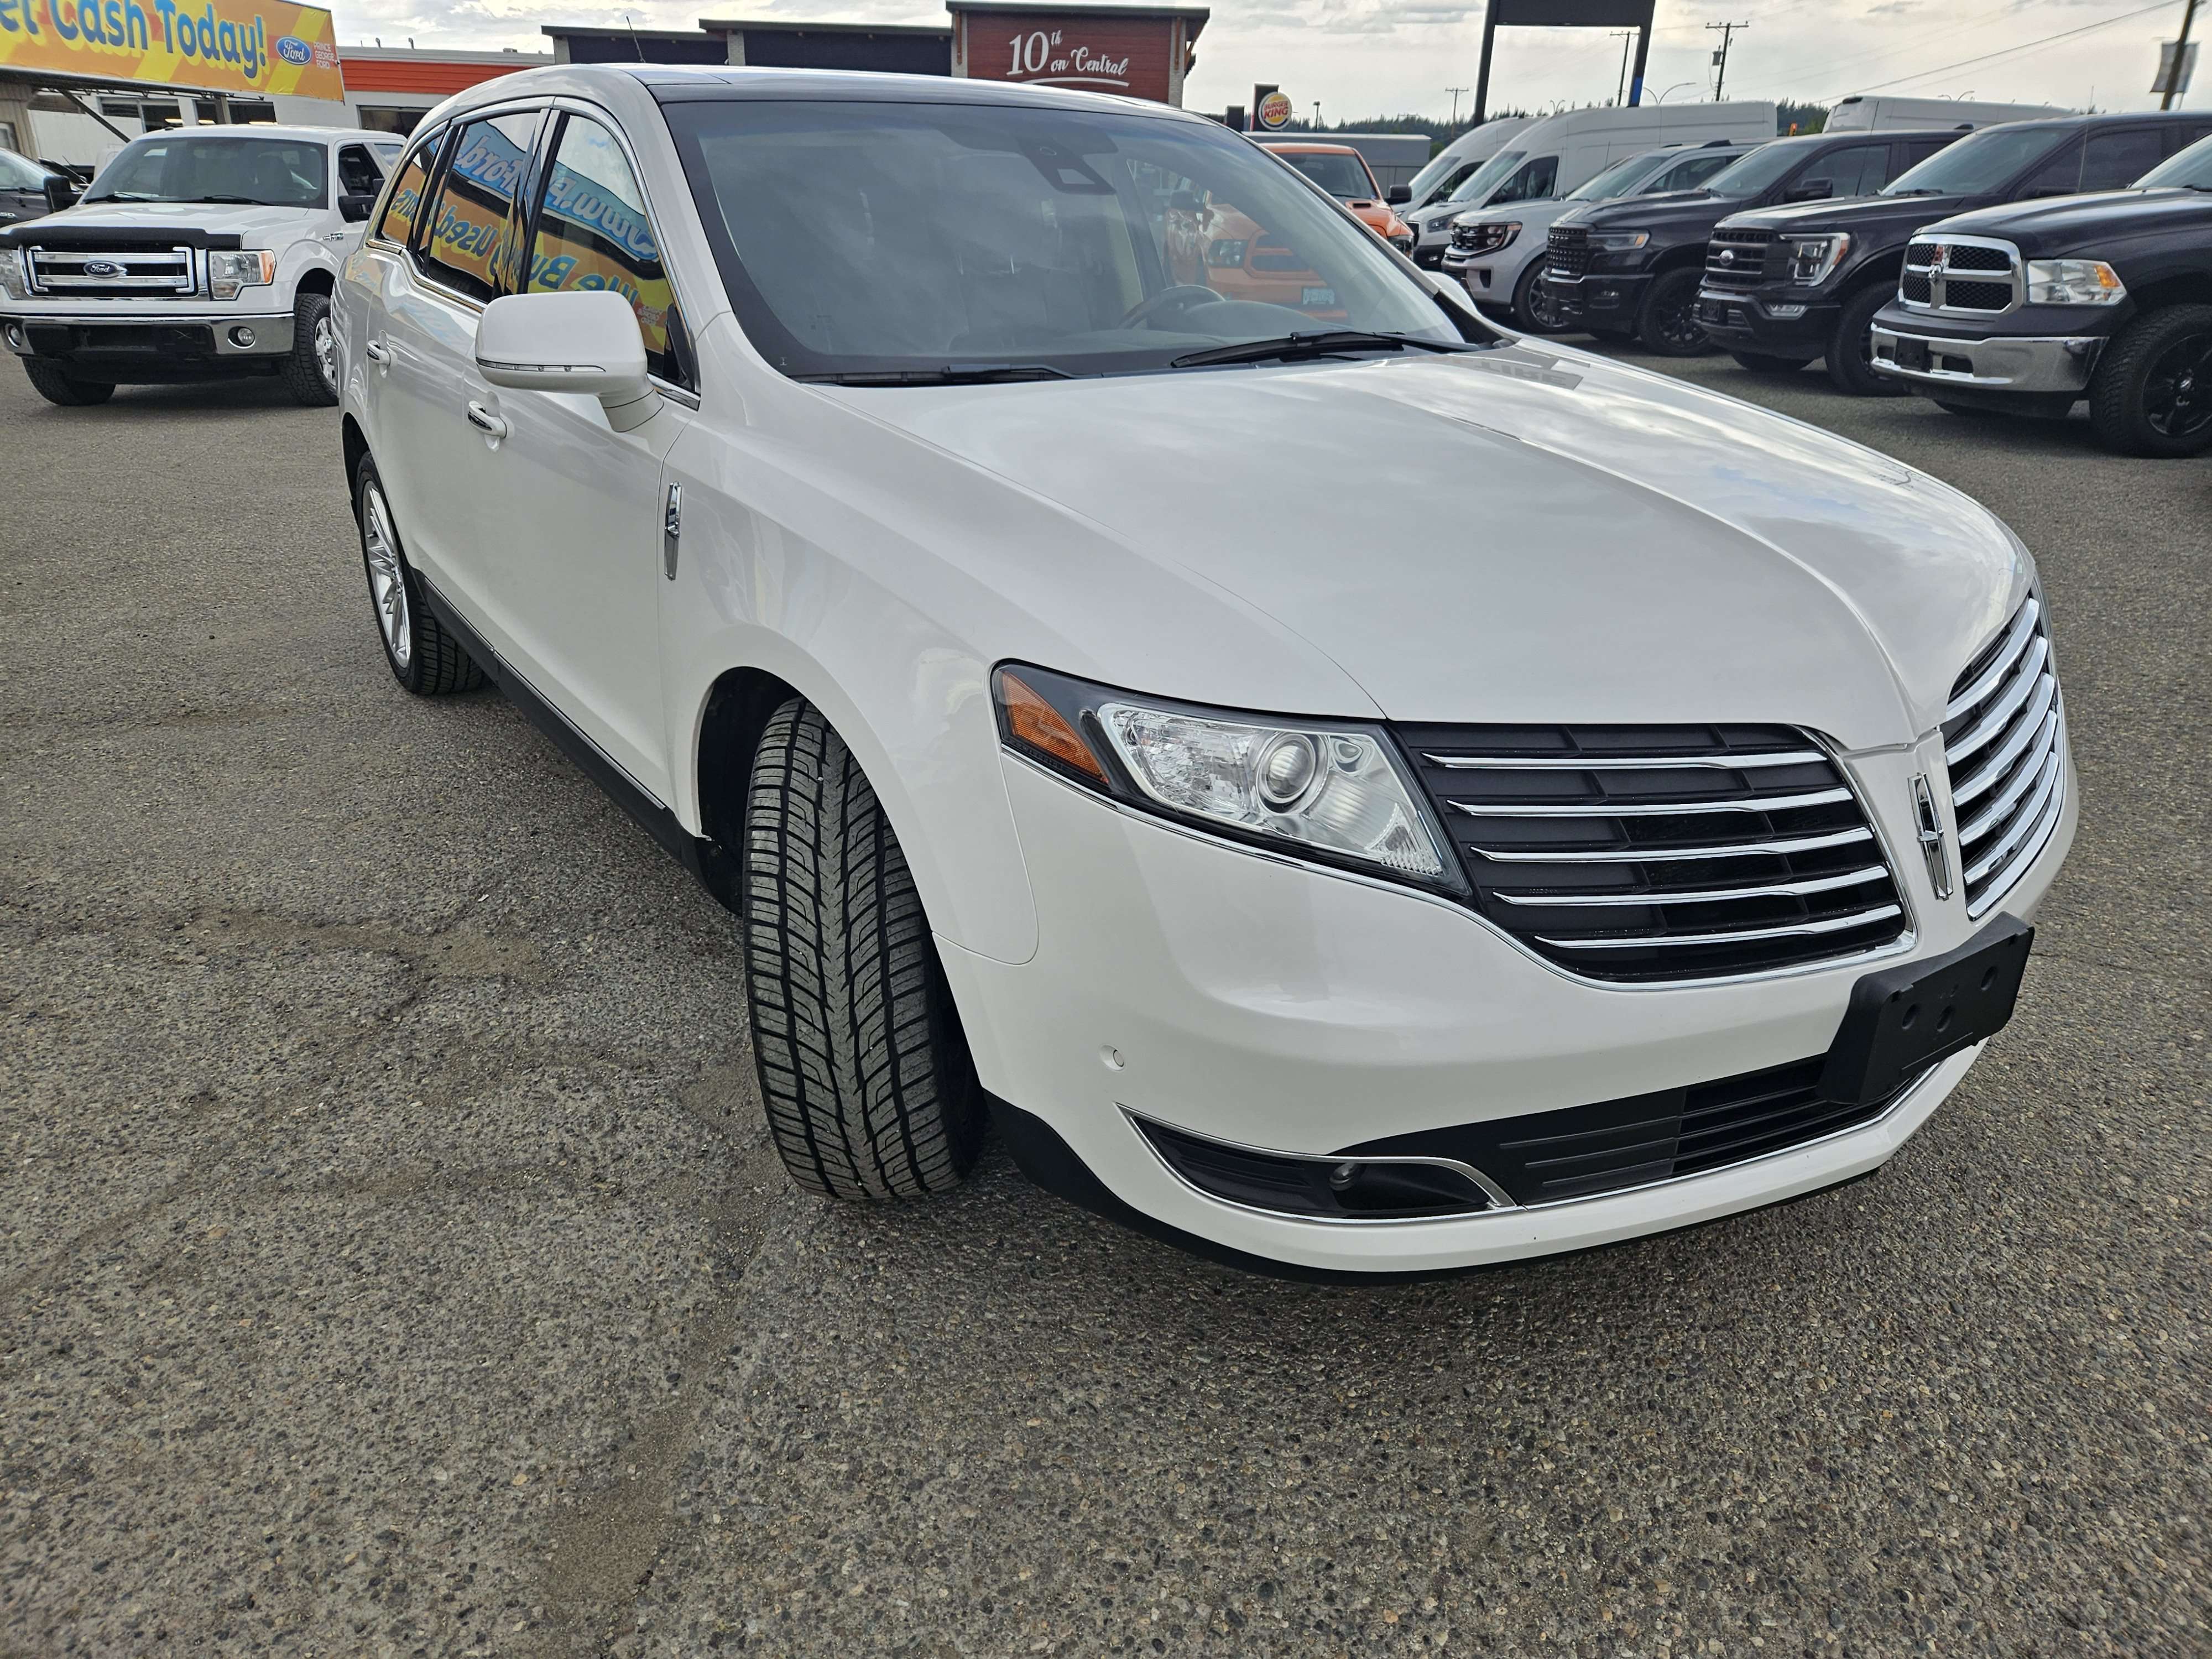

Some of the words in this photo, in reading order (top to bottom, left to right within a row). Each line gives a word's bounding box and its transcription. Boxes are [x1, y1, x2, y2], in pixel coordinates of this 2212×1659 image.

[48, 0, 148, 50] Cash
[154, 0, 265, 79] Today!
[284, 39, 305, 61] Ford
[314, 42, 332, 52] PRINCE
[315, 50, 335, 61] GEORGE
[1051, 59, 1070, 72] on
[1071, 46, 1129, 75] Central
[316, 59, 330, 69] FORD
[1264, 101, 1288, 109] BURGER
[1264, 107, 1288, 120] KING
[90, 264, 110, 273] Ford
